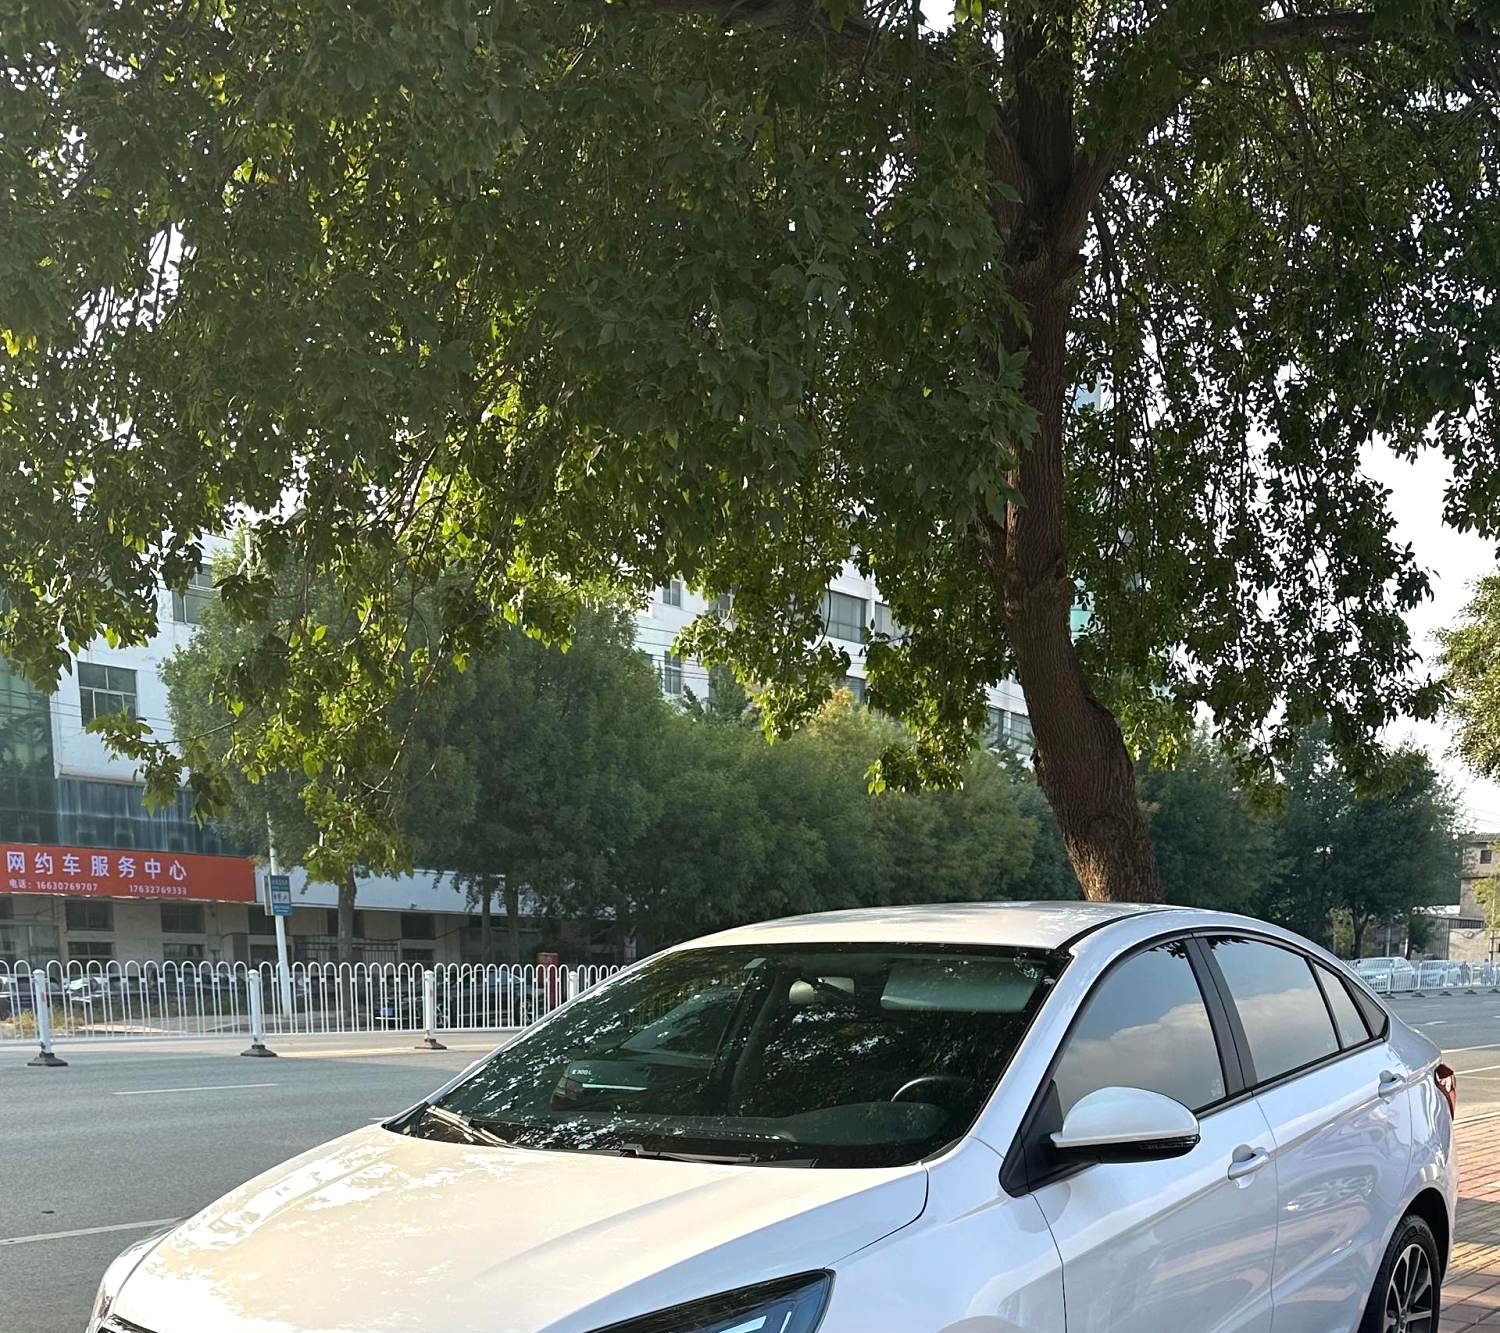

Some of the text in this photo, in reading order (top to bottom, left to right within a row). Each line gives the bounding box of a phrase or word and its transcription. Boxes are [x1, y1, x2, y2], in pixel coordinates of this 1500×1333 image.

[7, 851, 187, 880] 网约车服务中心
